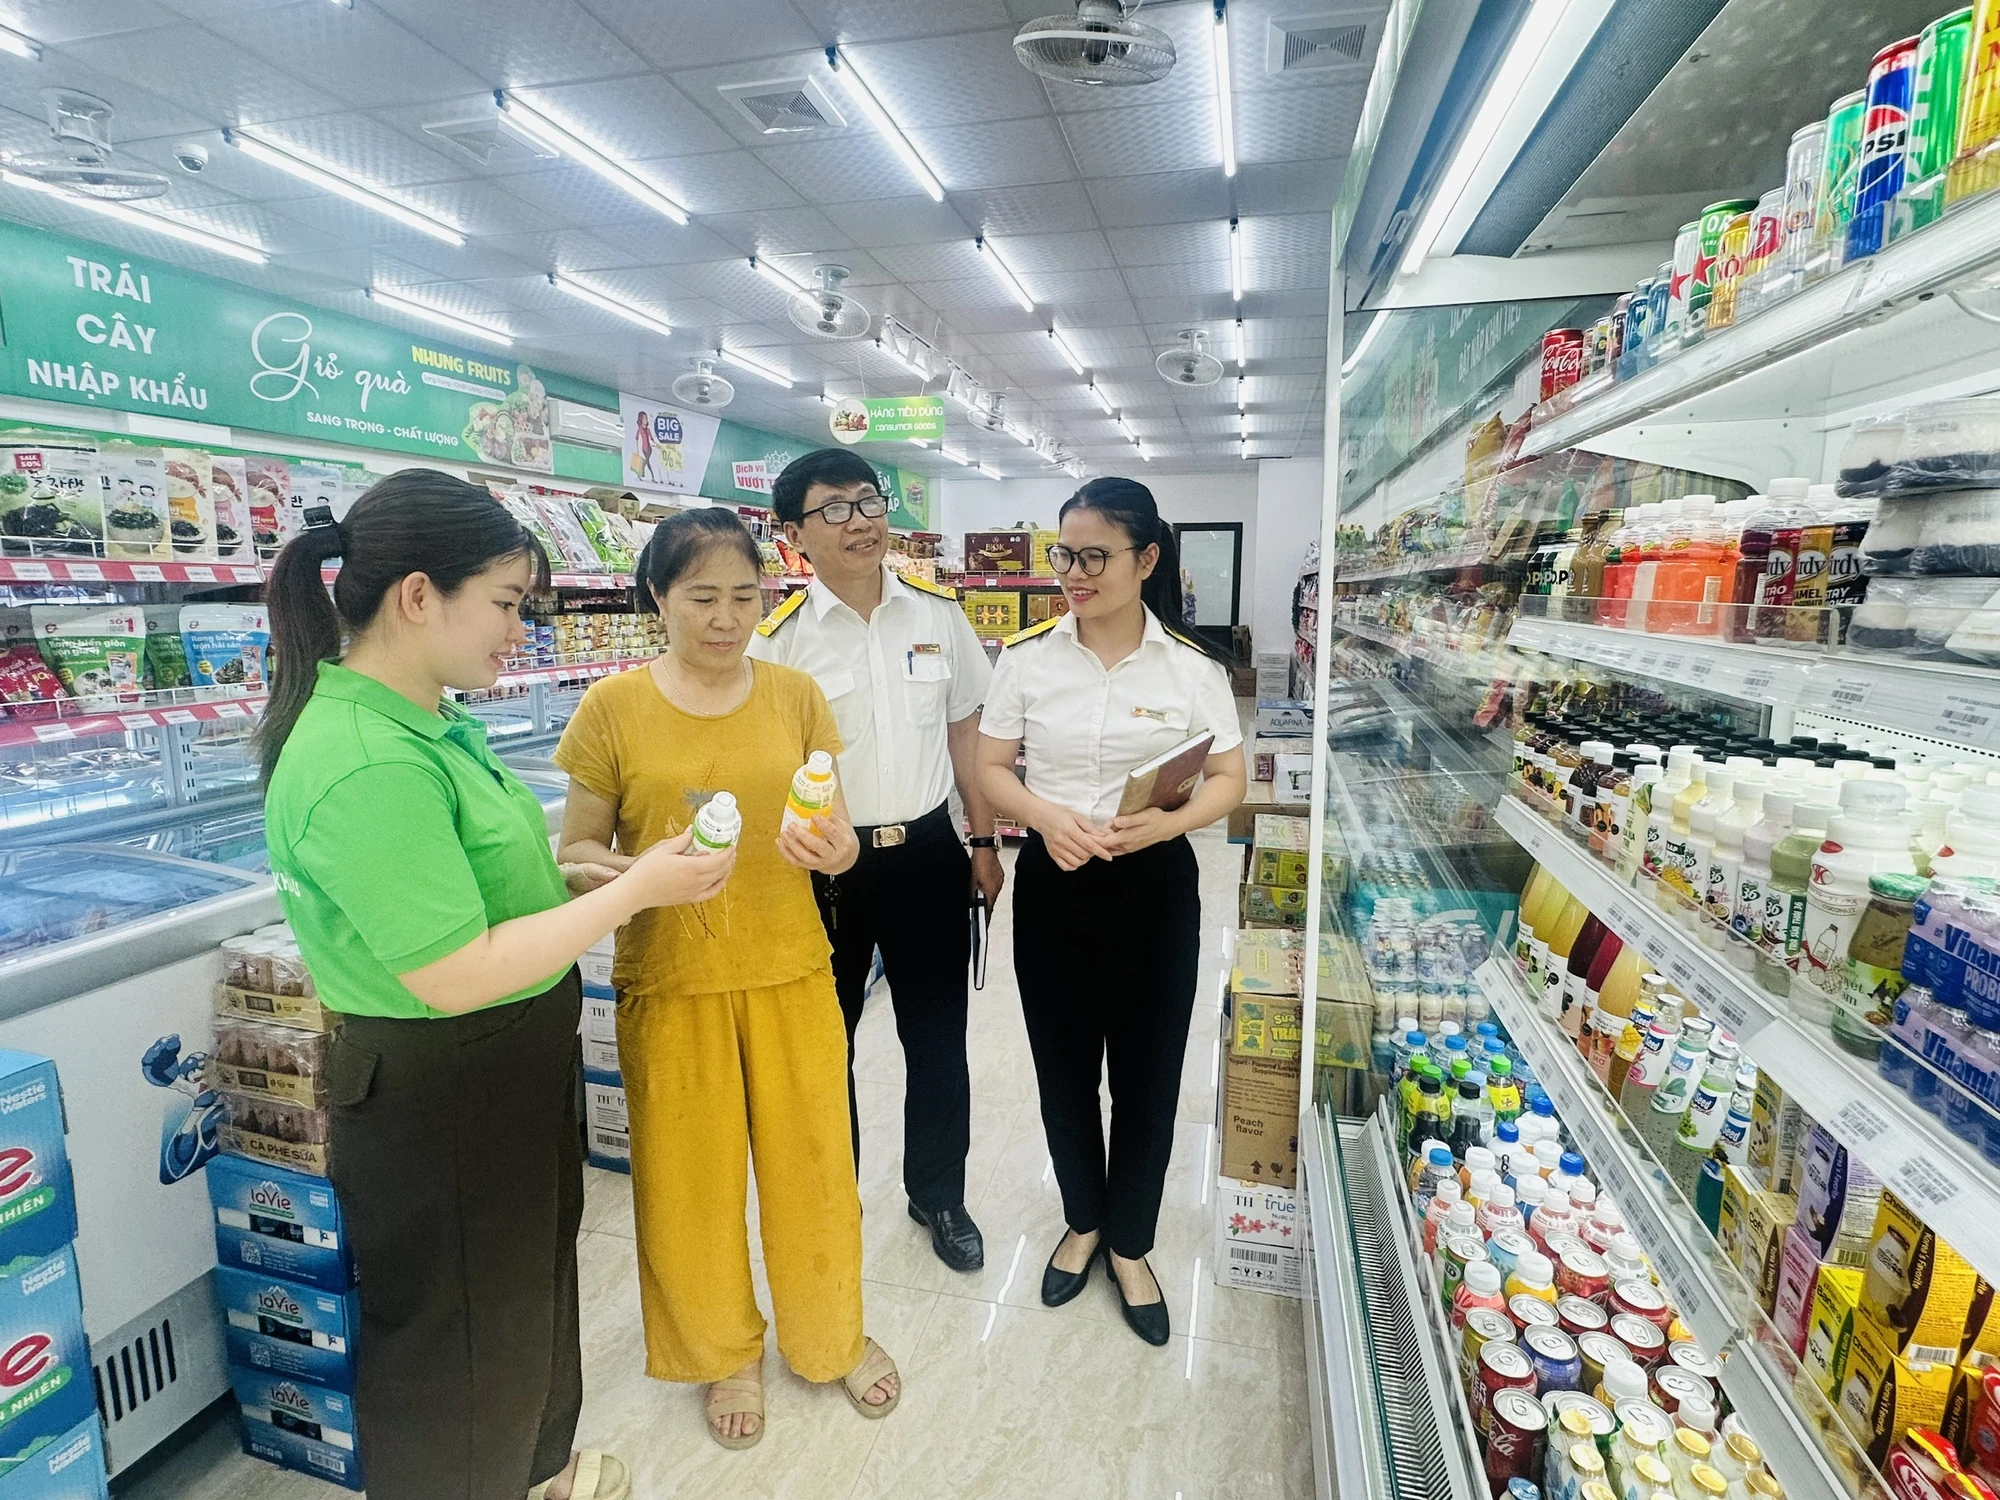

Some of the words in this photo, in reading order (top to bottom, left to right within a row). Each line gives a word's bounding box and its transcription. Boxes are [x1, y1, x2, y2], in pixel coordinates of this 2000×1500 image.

[67, 255, 151, 304] TRÁI
[76, 312, 156, 354] CÂY
[411, 345, 464, 375] NHUNG
[467, 360, 511, 386] FRUITS
[27, 358, 120, 400] NHẬP
[129, 372, 208, 411] KHẨU
[355, 370, 411, 412] quà
[870, 406, 895, 418] HÀNG
[897, 407, 917, 418] TIÊU
[918, 404, 944, 417] DÙNG
[306, 411, 342, 427] SANG
[344, 418, 385, 435] TRỌNG
[393, 426, 422, 441] CHẤT
[424, 431, 459, 447] LƯỢNG
[657, 418, 680, 431] BIG
[658, 431, 680, 442] SALE
[736, 476, 764, 489] VƯỢT
[1767, 557, 1792, 578] rdy
[1795, 589, 1822, 599] AMEL
[1270, 718, 1303, 728] AQUAFINA
[1742, 887, 1758, 900] 36
[1766, 904, 1781, 915] 36
[1693, 1091, 1710, 1109] Seed
[1233, 1115, 1264, 1128] Peach
[1236, 1125, 1264, 1137] flavor
[1722, 1123, 1741, 1141] Seed
[251, 1188, 291, 1210] laVie
[1233, 1195, 1253, 1208] TH
[1265, 1197, 1296, 1212] true
[1883, 1191, 1923, 1230] Chestnut
[1913, 1258, 1928, 1290] Favorite
[259, 1293, 299, 1315] laVie
[271, 1387, 310, 1410] laVie
[1874, 1407, 1889, 1436] Favorite
